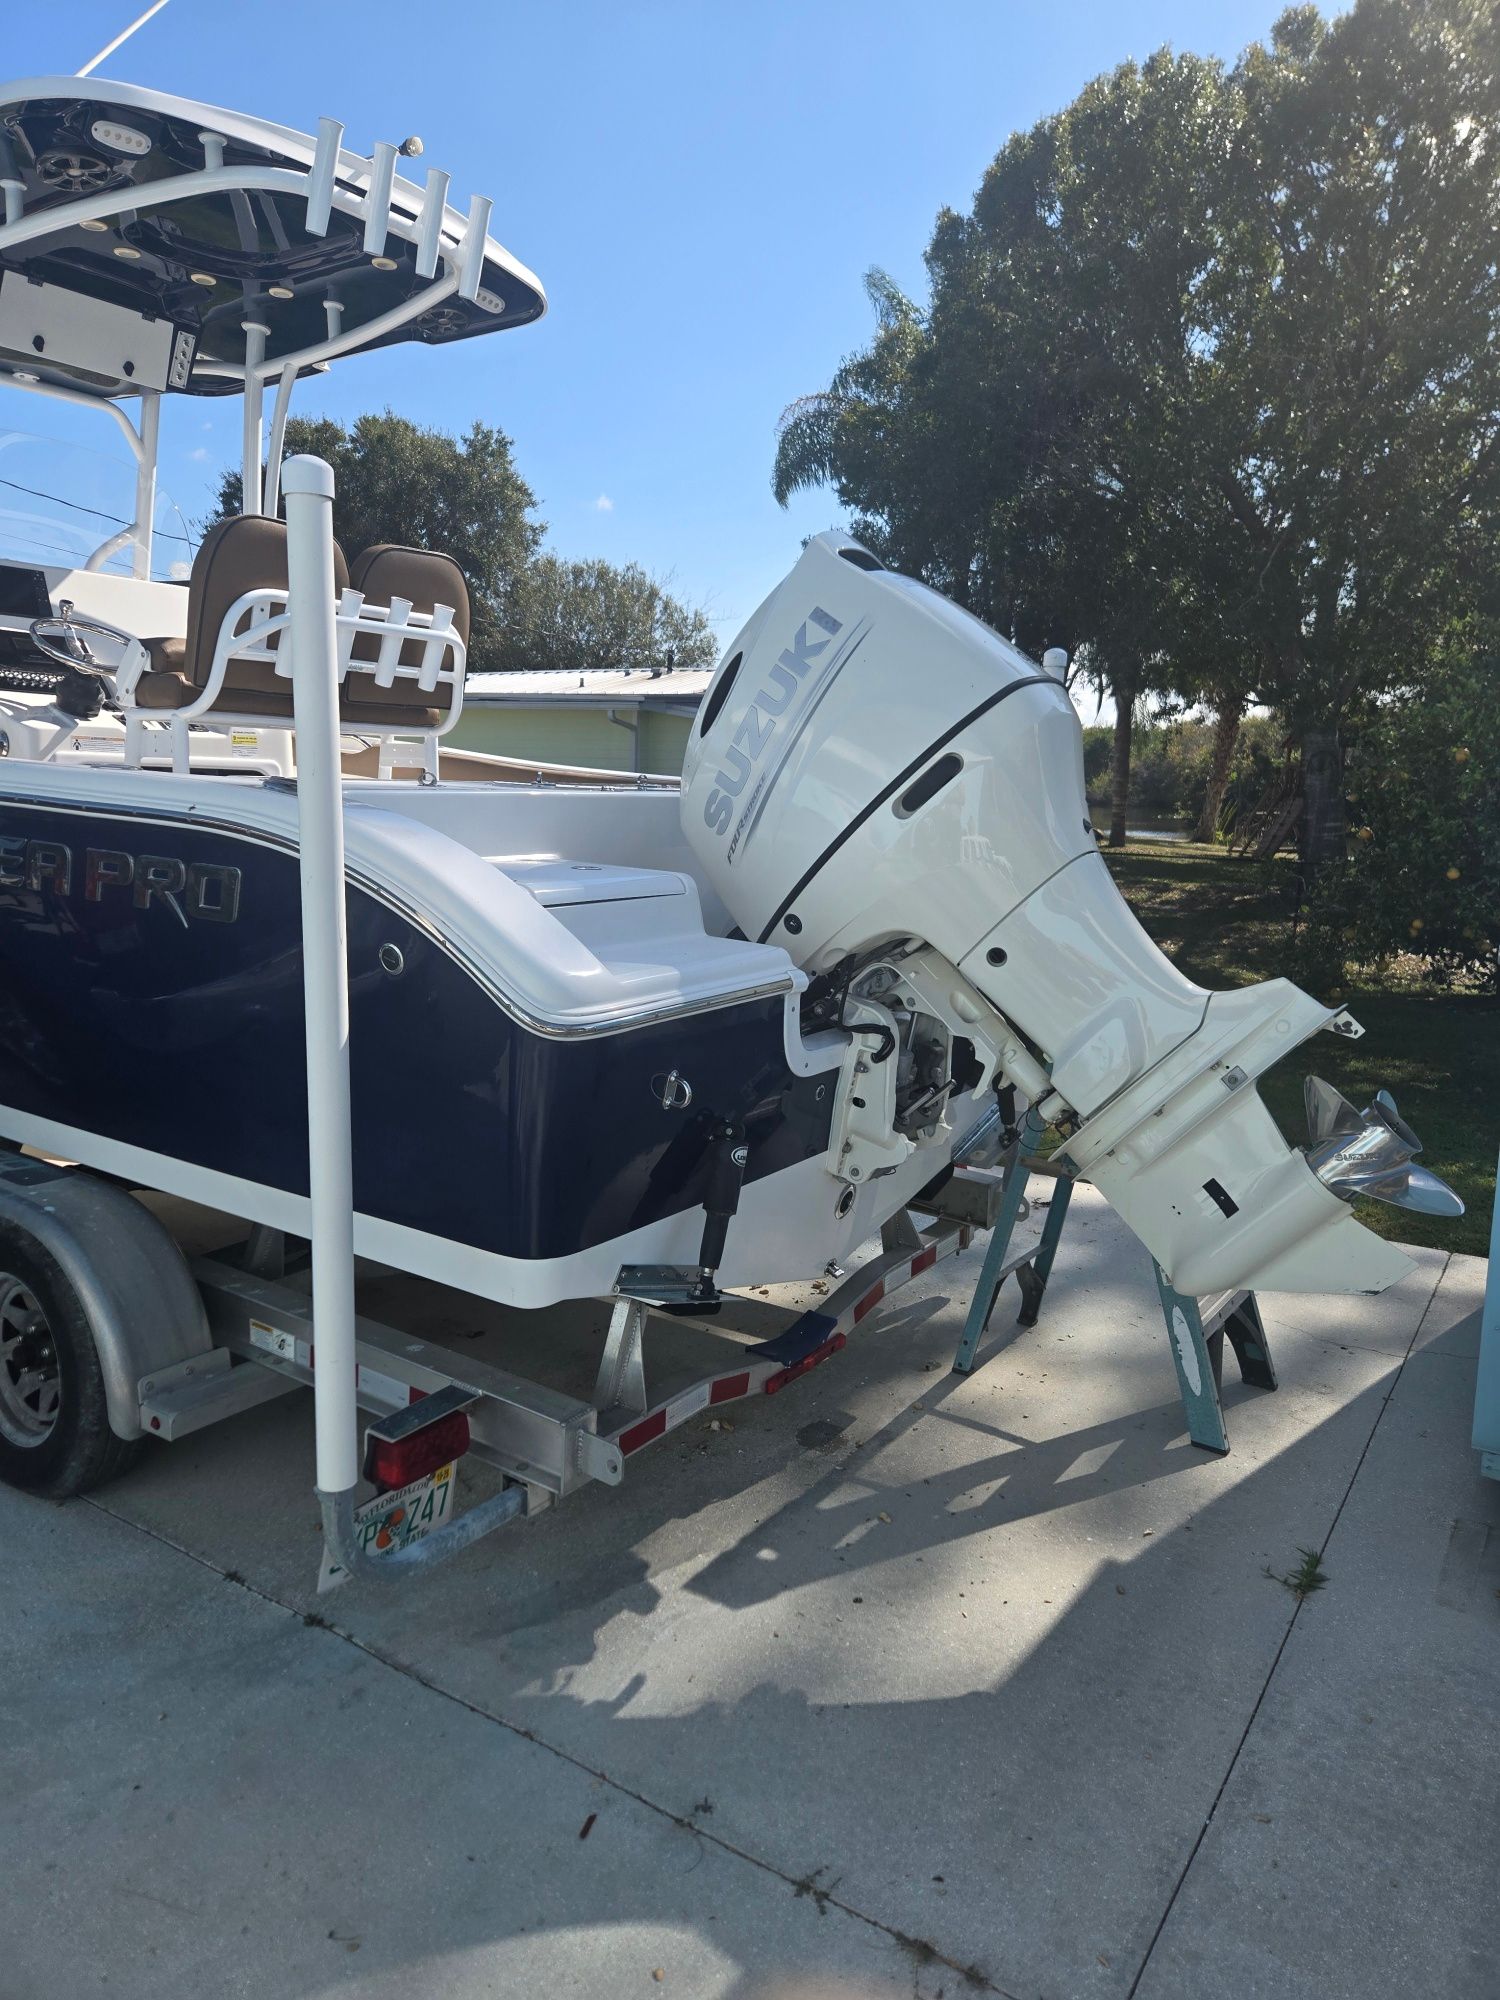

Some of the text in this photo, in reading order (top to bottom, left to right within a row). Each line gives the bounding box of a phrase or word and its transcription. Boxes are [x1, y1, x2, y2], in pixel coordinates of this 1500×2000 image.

[704, 606, 843, 836] SUZUKI
[85, 846, 242, 929] PRO
[406, 1481, 450, 1535] Z47
